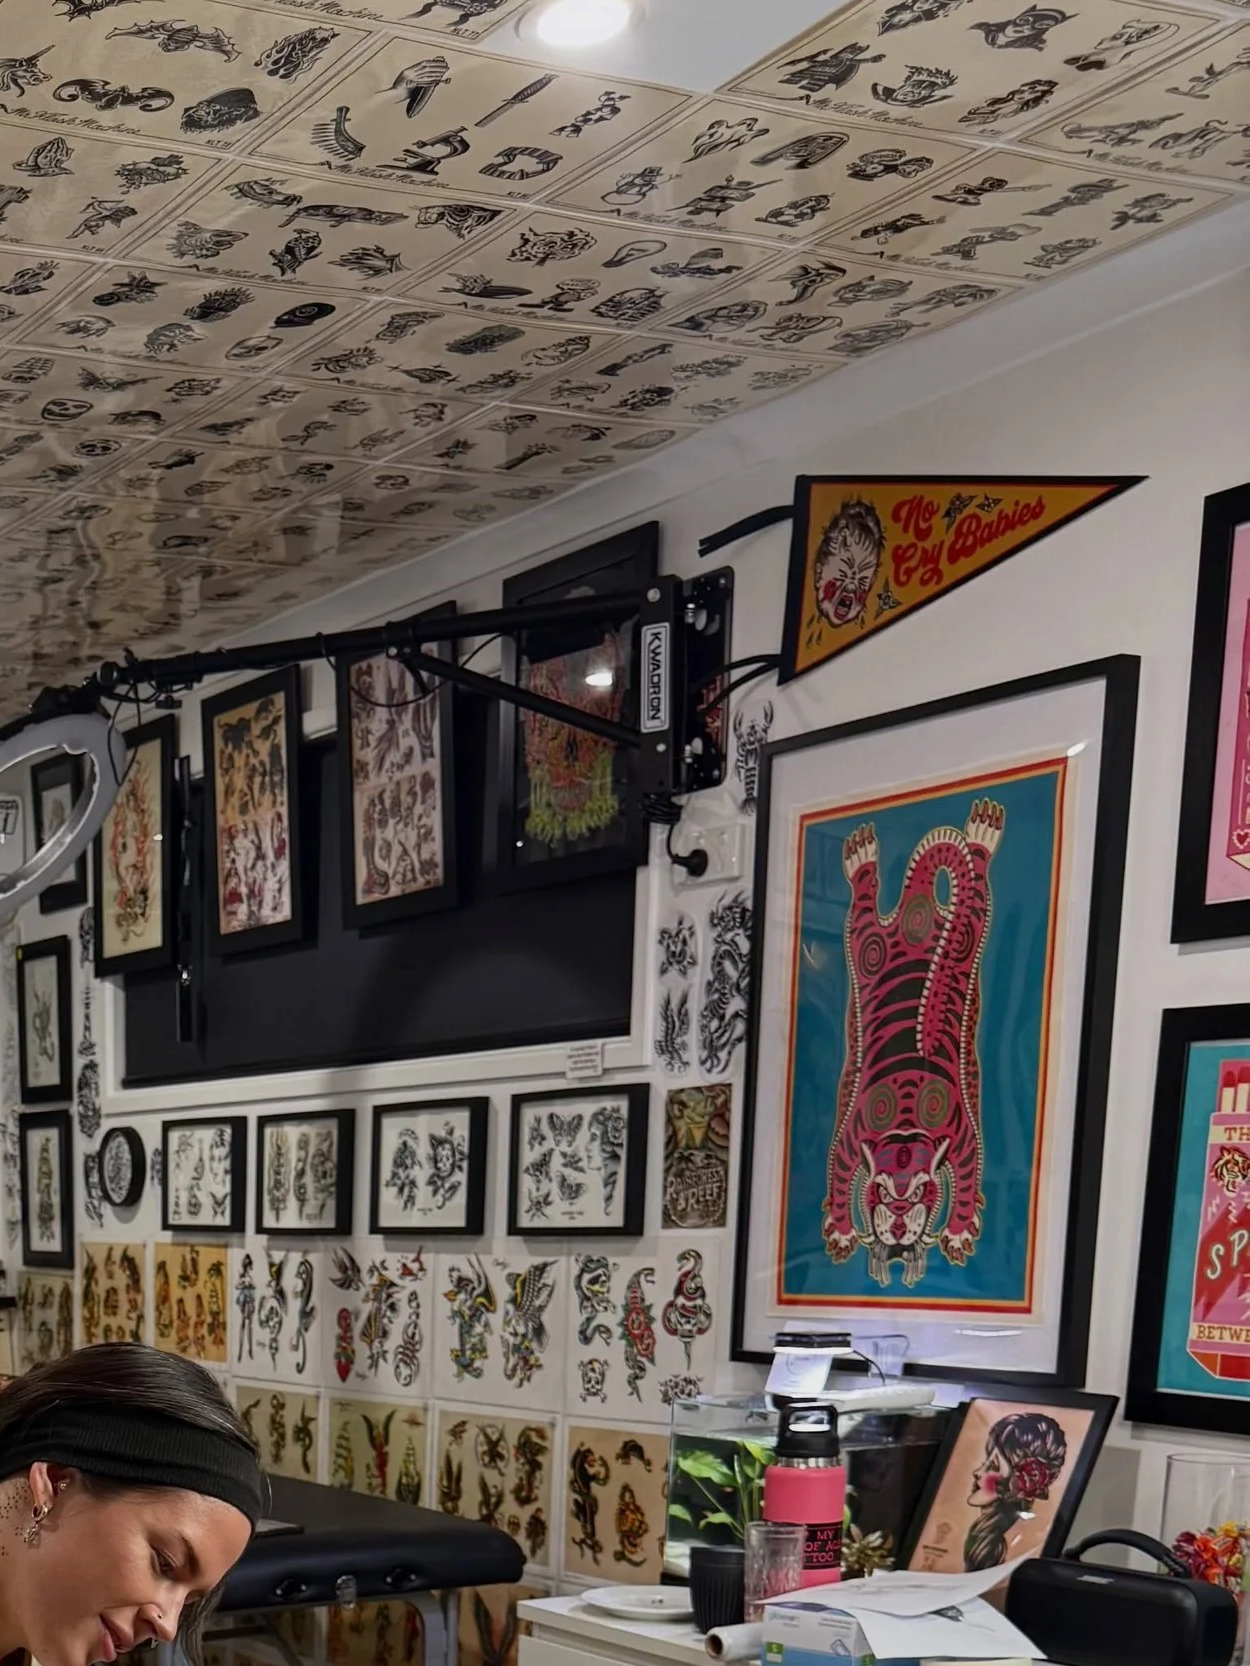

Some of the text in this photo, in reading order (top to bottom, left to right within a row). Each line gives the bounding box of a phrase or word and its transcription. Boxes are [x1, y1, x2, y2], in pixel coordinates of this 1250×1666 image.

[891, 495, 940, 542] No
[891, 495, 1046, 588] Cry Babies
[647, 631, 662, 720] KWADRON
[666, 1167, 724, 1199] RAINFOREST
[687, 1182, 722, 1211] REEF
[805, 1541, 821, 1552] OF
[817, 1530, 834, 1540] MY
